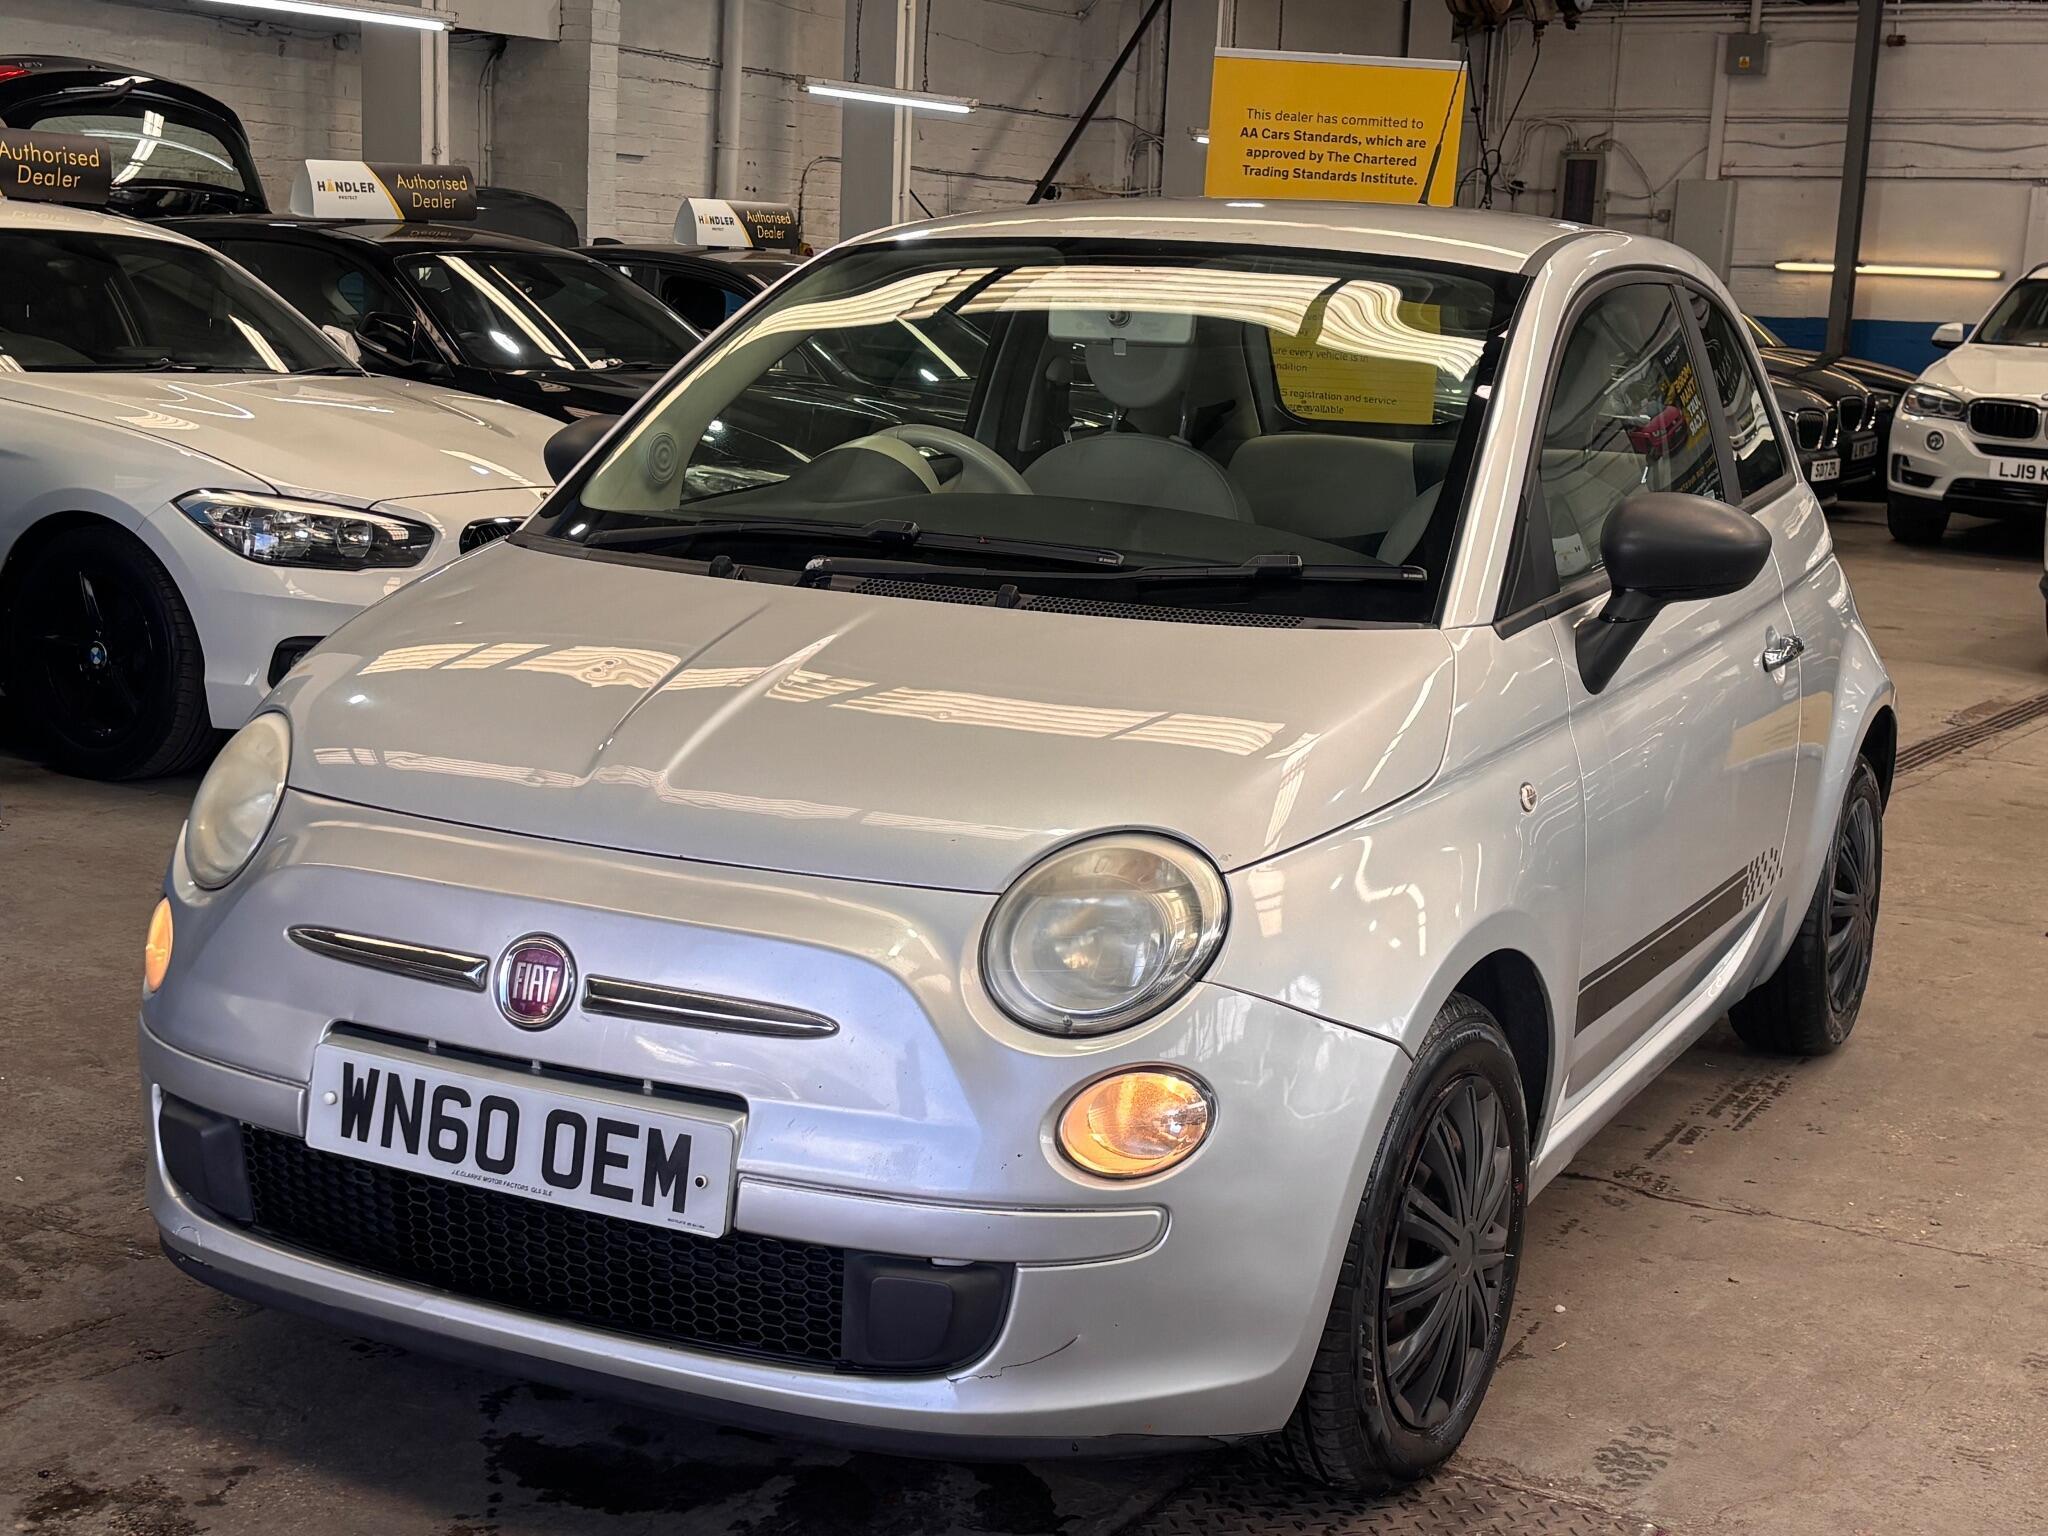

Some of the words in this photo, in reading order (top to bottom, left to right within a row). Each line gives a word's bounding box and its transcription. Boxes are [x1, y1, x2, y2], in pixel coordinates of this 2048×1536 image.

[1247, 108, 1271, 120] This
[1275, 110, 1313, 122] dealer
[1317, 112, 1338, 124] has
[1341, 116, 1408, 129] committed
[1411, 118, 1424, 129] to
[1240, 127, 1258, 138] AA
[1262, 128, 1290, 140] Cars
[1294, 130, 1362, 146] Standards,
[1366, 135, 1402, 147] which
[1406, 139, 1426, 150] are
[0, 140, 100, 168] Authorised
[1246, 148, 1306, 160] approved
[1309, 150, 1324, 163] by
[1327, 151, 1350, 163] The
[1353, 152, 1417, 167] Chartered
[17, 164, 81, 188] Dealer
[396, 173, 468, 191] Authorised
[1242, 164, 1289, 180] Trading
[1293, 168, 1357, 182] Standards
[1361, 172, 1418, 186] Institute.
[412, 192, 456, 209] Dealer
[746, 210, 791, 225] Authorised
[756, 225, 785, 239] Dealer
[1289, 348, 1314, 360] every
[1316, 350, 1348, 362] vehicle
[1290, 390, 1342, 402] registration
[1344, 392, 1362, 402] and
[1364, 394, 1397, 406] service
[1999, 461, 2037, 480] LJ19
[511, 961, 559, 1004] FIAT
[339, 1061, 520, 1175] WN60
[540, 1108, 693, 1215] OEM
[483, 1175, 503, 1186] MOTOR
[503, 1180, 529, 1192] FACTORS
